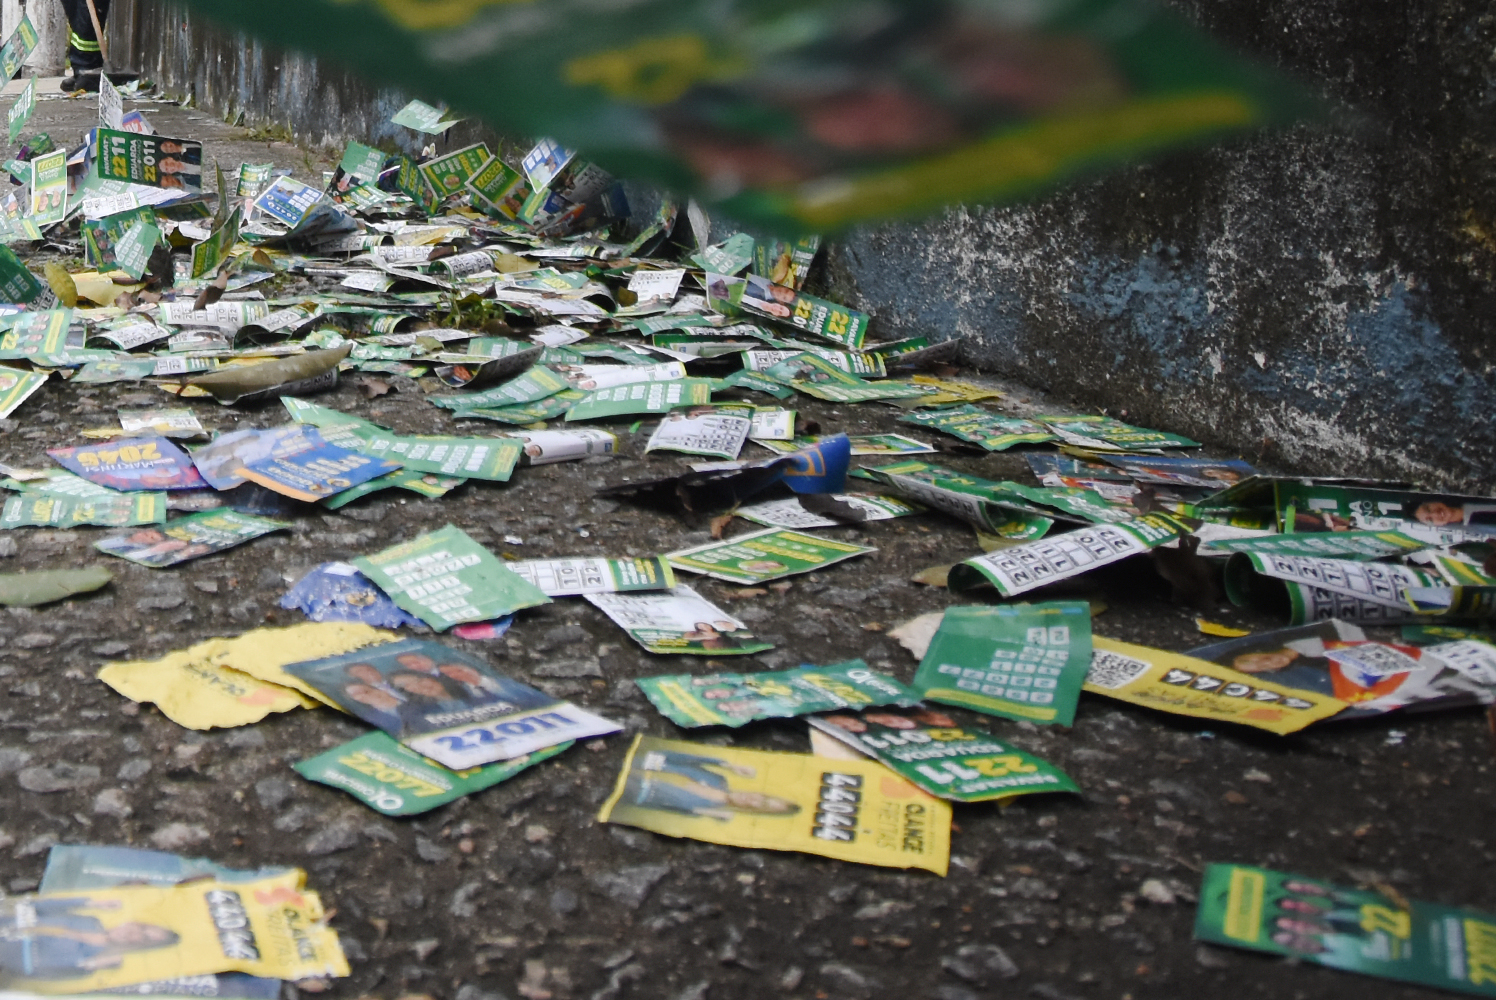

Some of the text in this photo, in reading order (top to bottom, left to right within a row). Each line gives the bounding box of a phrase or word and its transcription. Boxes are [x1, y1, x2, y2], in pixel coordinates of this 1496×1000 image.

[112, 137, 128, 178] 2211
[130, 139, 138, 179] EDUARDA
[143, 140, 157, 182] 22011
[243, 171, 268, 182] 2211
[477, 162, 503, 188] 22077
[1081, 536, 1107, 555] 10
[1101, 530, 1129, 548] 22
[564, 567, 576, 587] 10
[587, 565, 602, 586] 22
[1370, 569, 1389, 593] 10
[433, 712, 579, 751] 22011
[861, 728, 977, 749] 22011
[338, 753, 446, 798] 22077
[915, 756, 1038, 785] 2211
[812, 772, 863, 842] 44044
[207, 889, 261, 960] 44044
